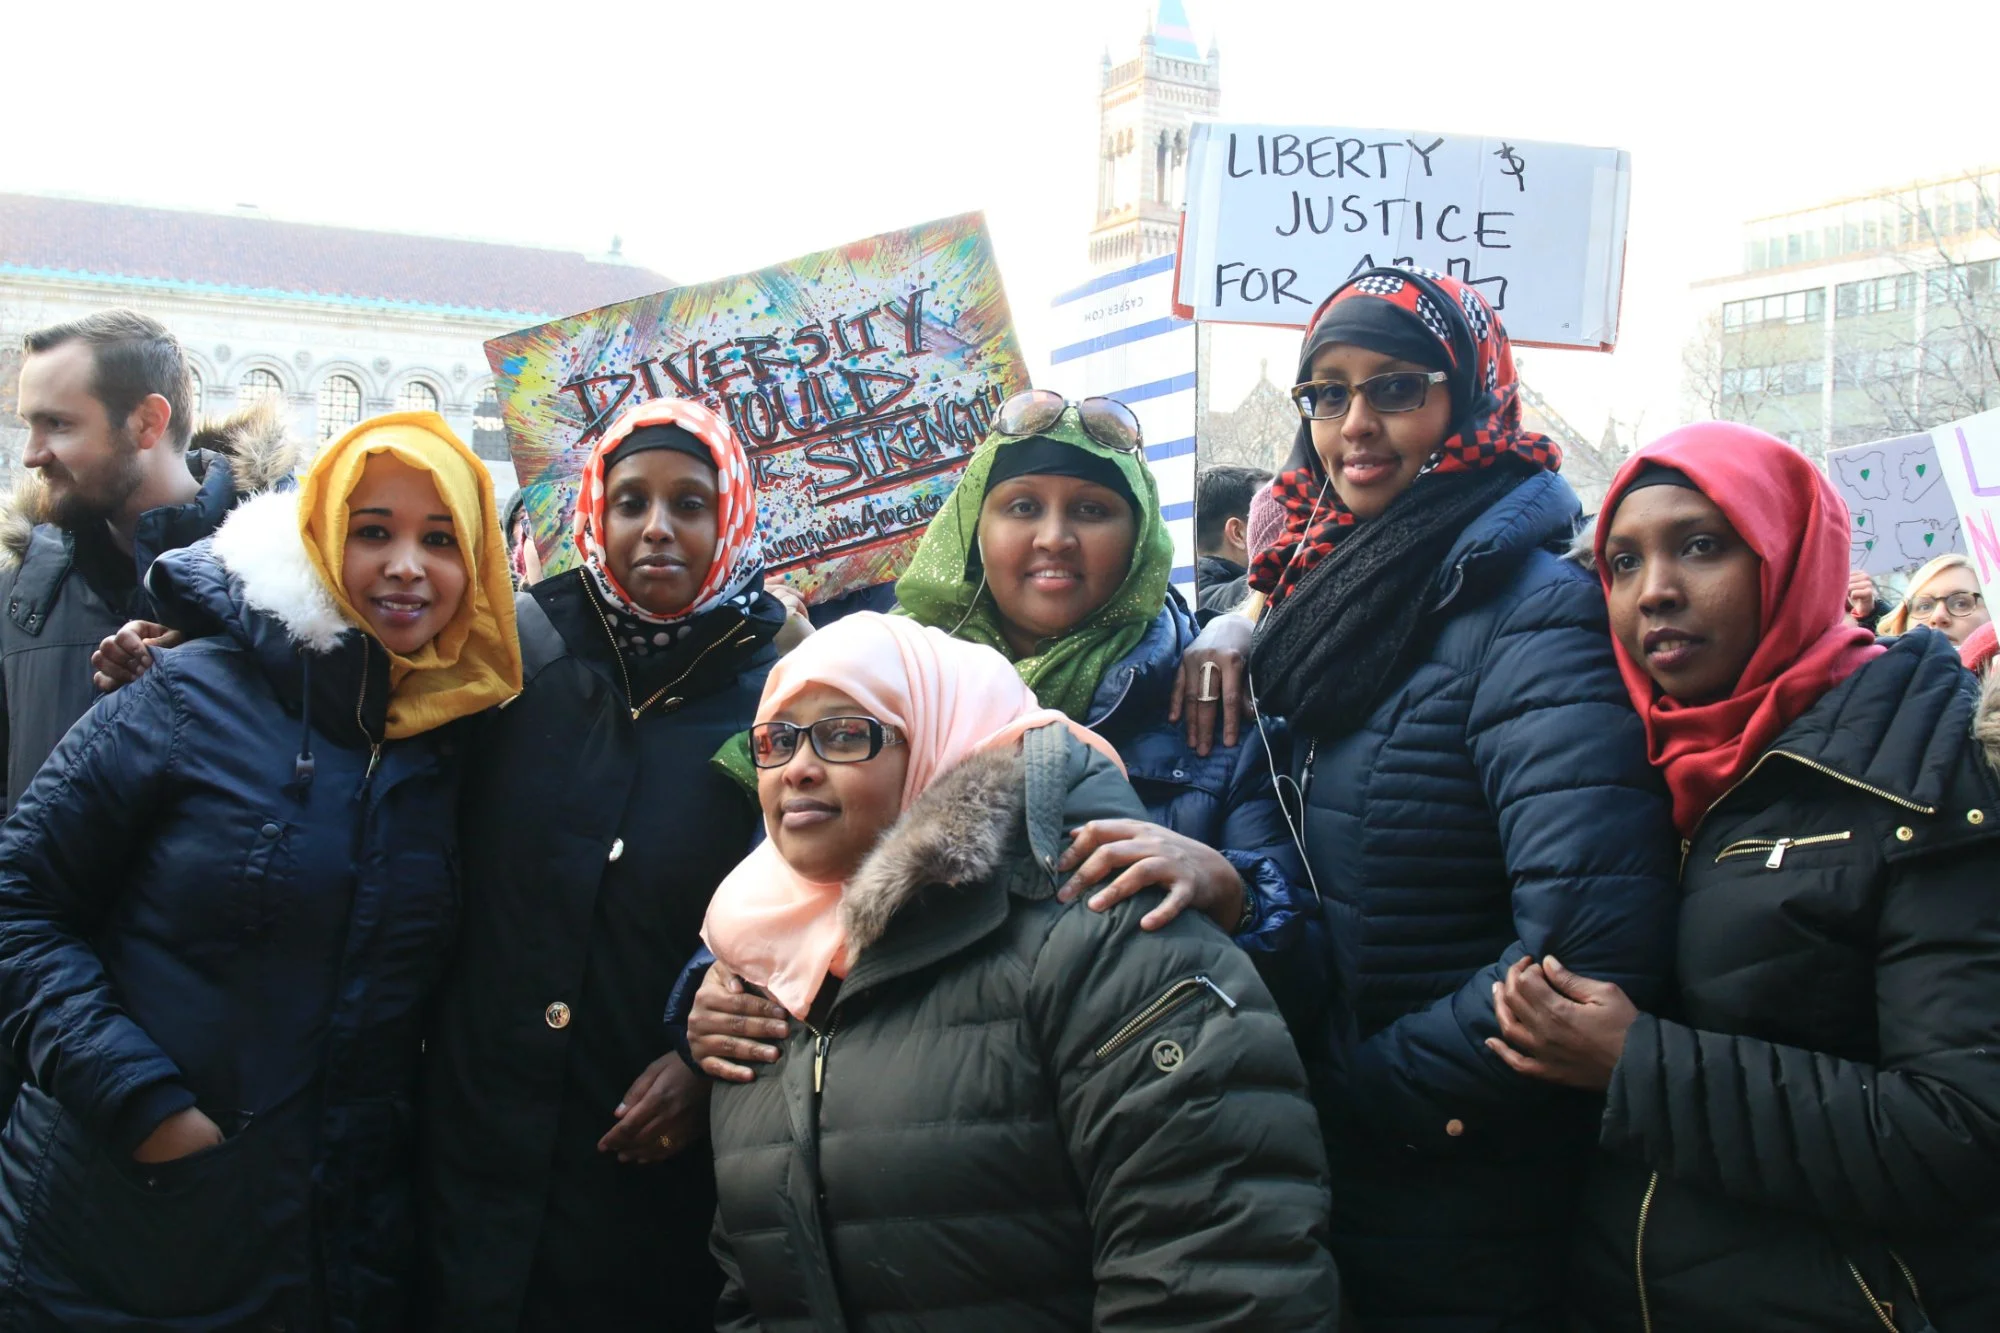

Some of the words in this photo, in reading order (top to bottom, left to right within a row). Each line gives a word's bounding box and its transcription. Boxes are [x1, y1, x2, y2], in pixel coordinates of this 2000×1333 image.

[1227, 132, 1445, 179] LIBERTY
[1275, 190, 1515, 249] JUSTICE
[1215, 261, 1313, 307] FOR
[559, 288, 931, 449] DIVERSITY
